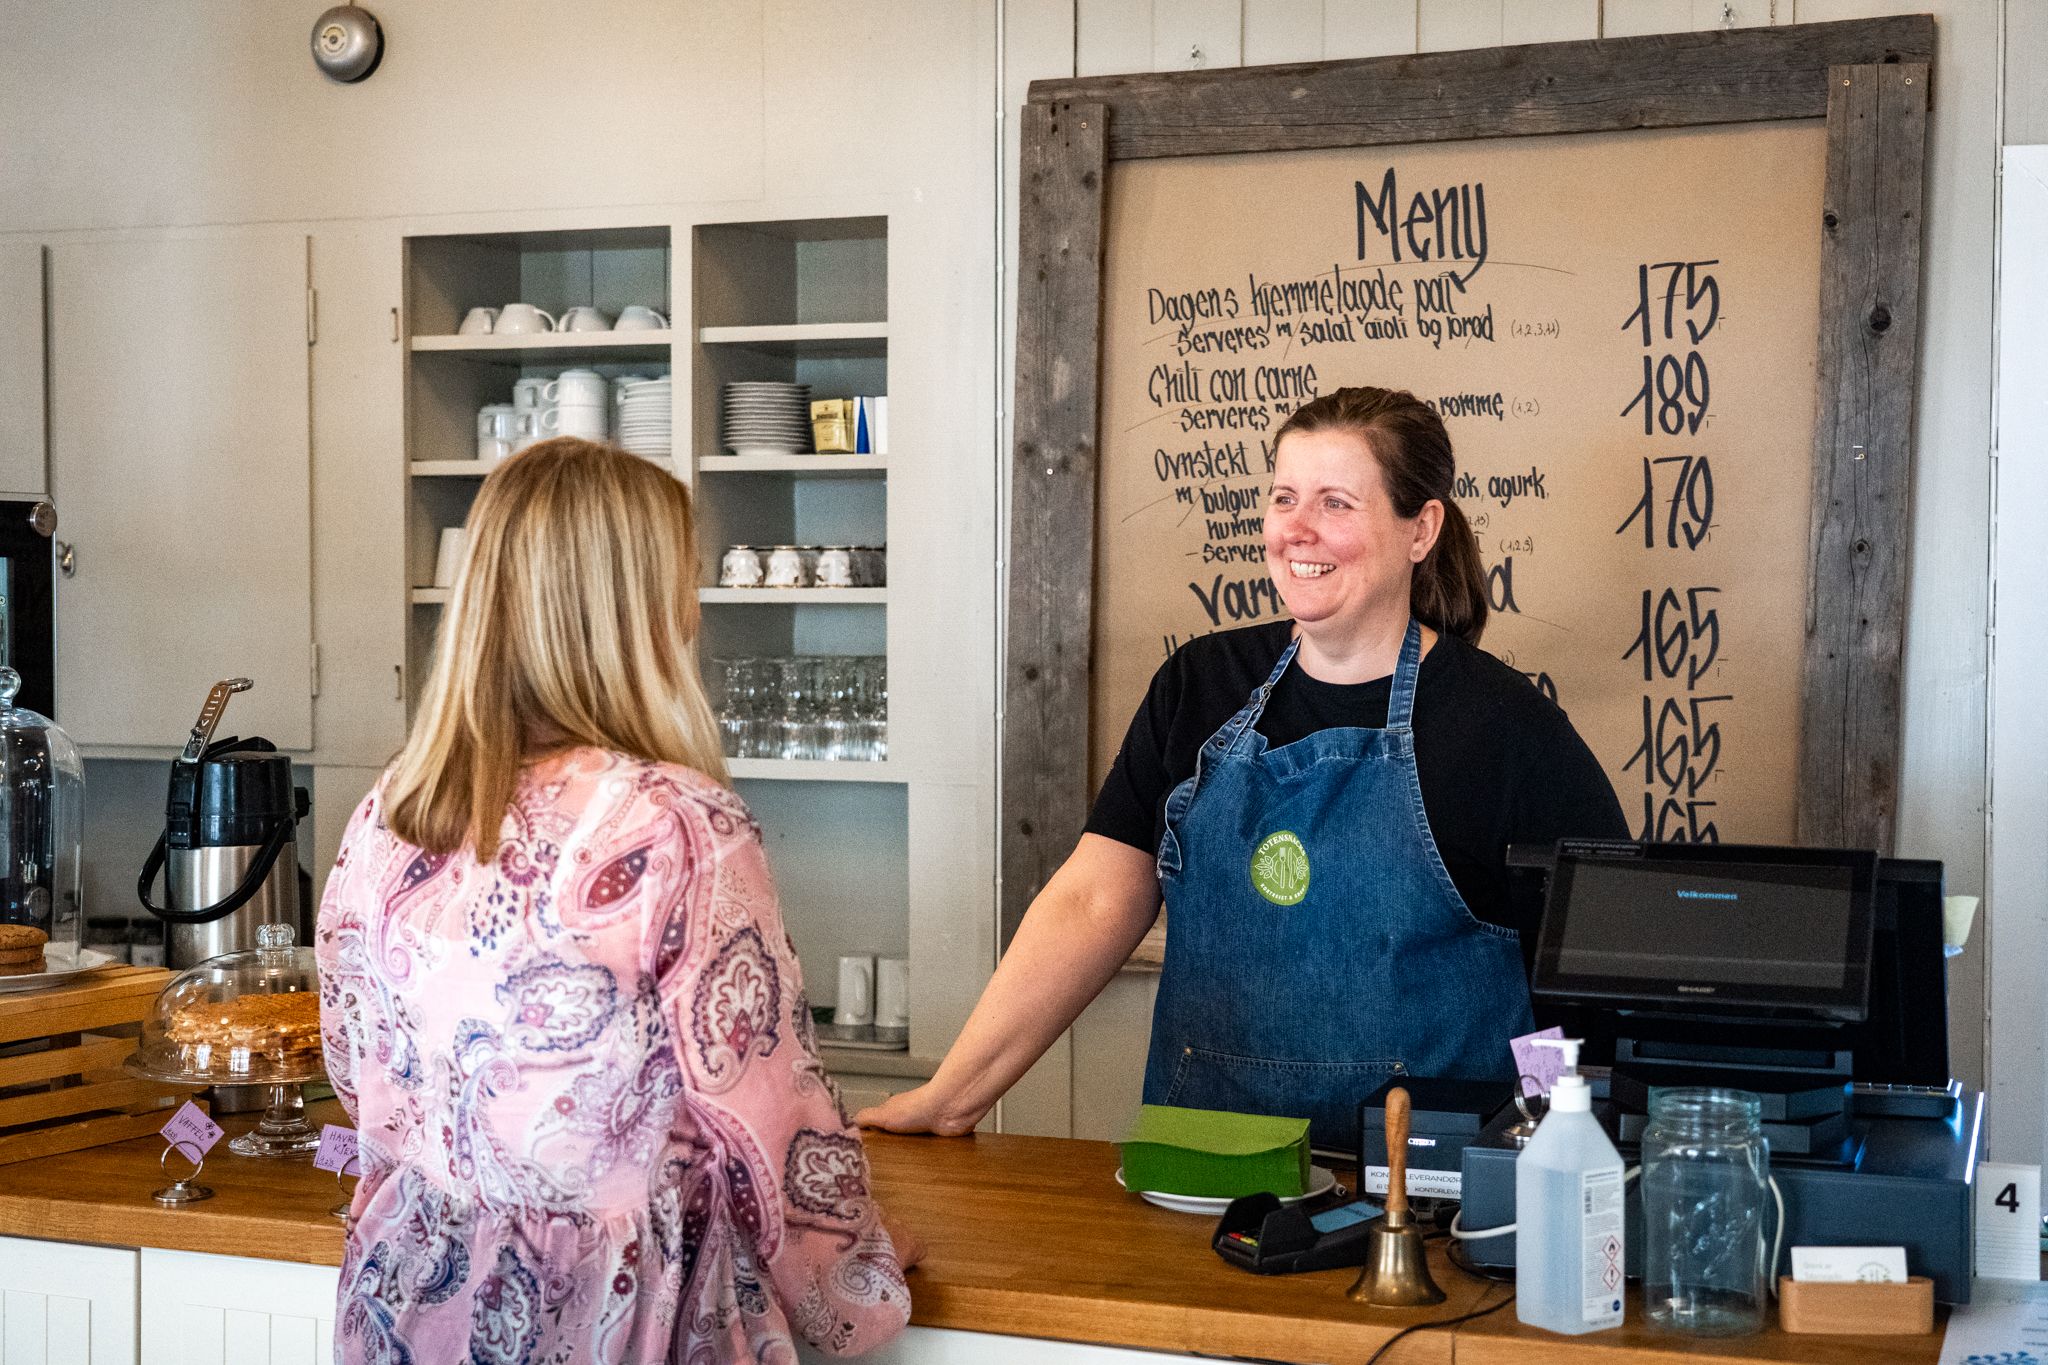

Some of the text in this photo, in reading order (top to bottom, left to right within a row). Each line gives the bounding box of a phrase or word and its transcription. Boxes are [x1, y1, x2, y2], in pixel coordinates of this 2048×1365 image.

[1355, 167, 1488, 293] Meny
[1148, 286, 1239, 334] Dagens
[1249, 263, 1403, 333] hjemmelagde
[1300, 314, 1356, 347] salat
[1418, 317, 1442, 349] og
[1149, 360, 1319, 408] Chili con carne
[1154, 440, 1250, 482] Ovnstekt
[1200, 484, 1260, 520] bulgur
[1676, 889, 1738, 900] Velkommen
[1994, 1183, 2020, 1213] 4
